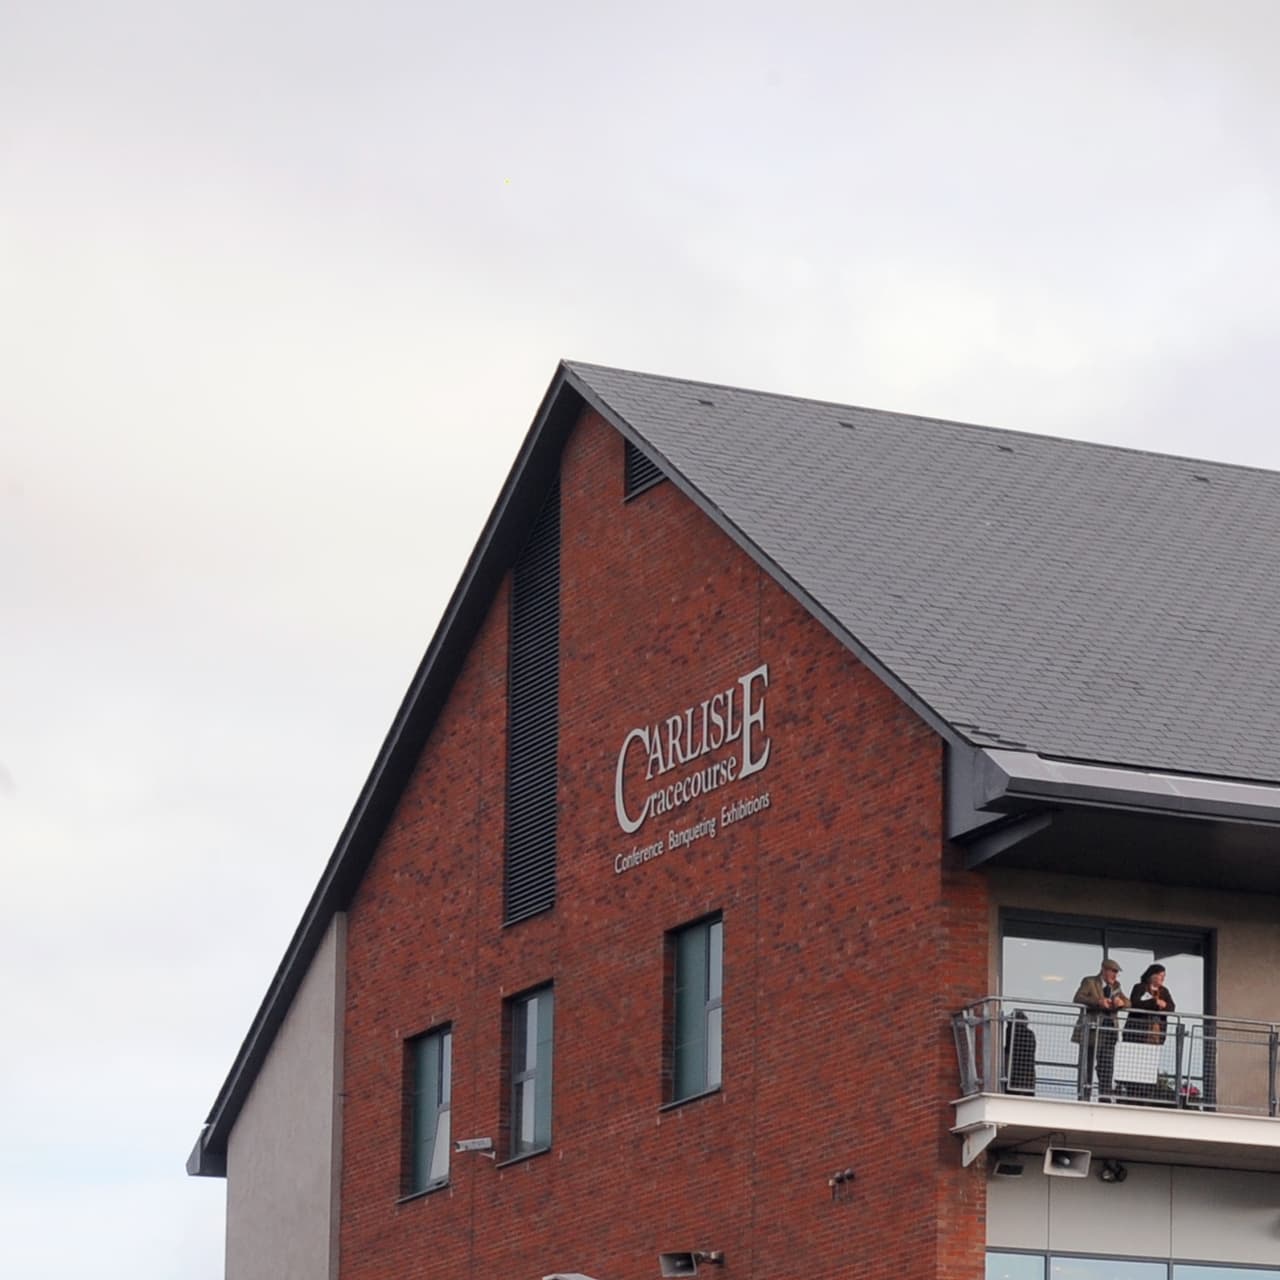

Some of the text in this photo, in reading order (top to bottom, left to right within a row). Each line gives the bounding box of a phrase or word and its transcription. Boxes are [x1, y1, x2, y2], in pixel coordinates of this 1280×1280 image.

[614, 663, 771, 834] CARLISLE
[649, 755, 738, 818] racecourse
[614, 792, 771, 874] Conference Banqueting Exhibitions
